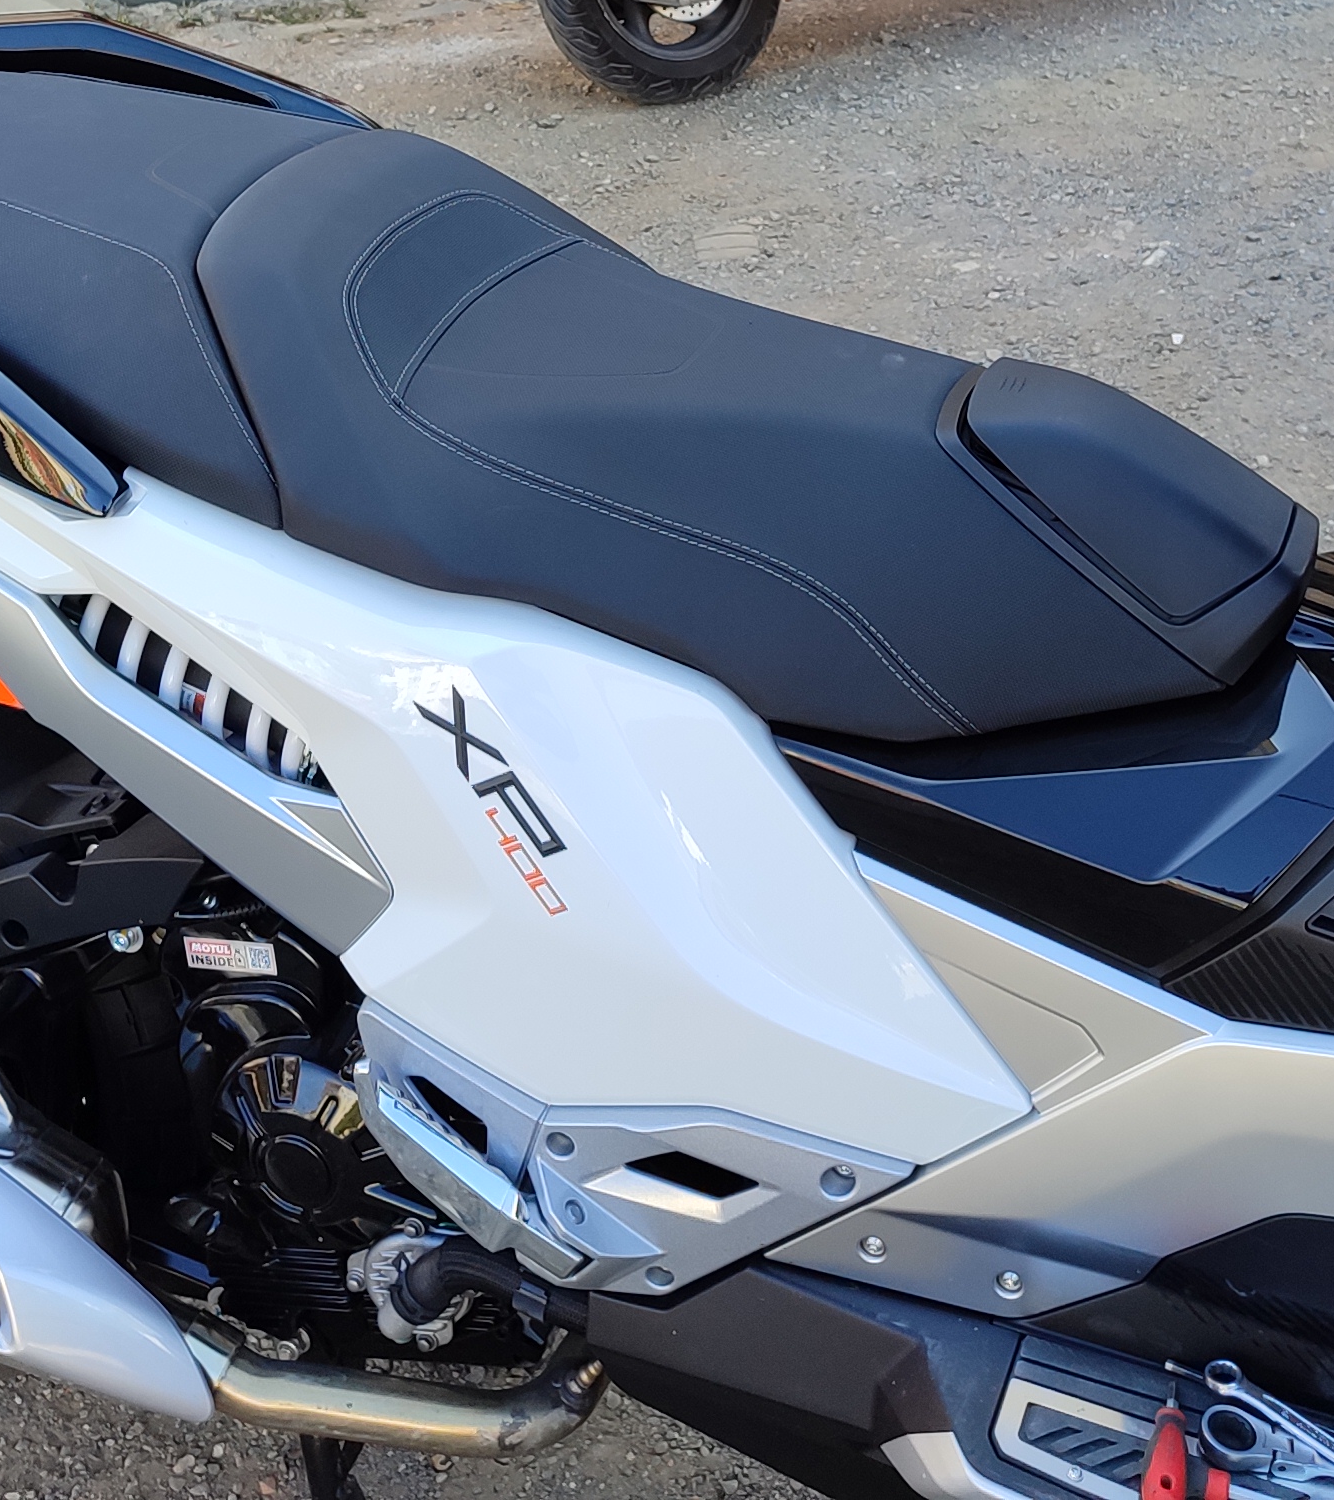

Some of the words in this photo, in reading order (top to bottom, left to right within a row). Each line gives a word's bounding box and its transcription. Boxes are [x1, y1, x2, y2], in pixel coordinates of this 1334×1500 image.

[413, 683, 568, 858] XP
[485, 806, 569, 916] 400
[190, 942, 231, 955] MOTUL
[190, 954, 234, 967] INSIDE
